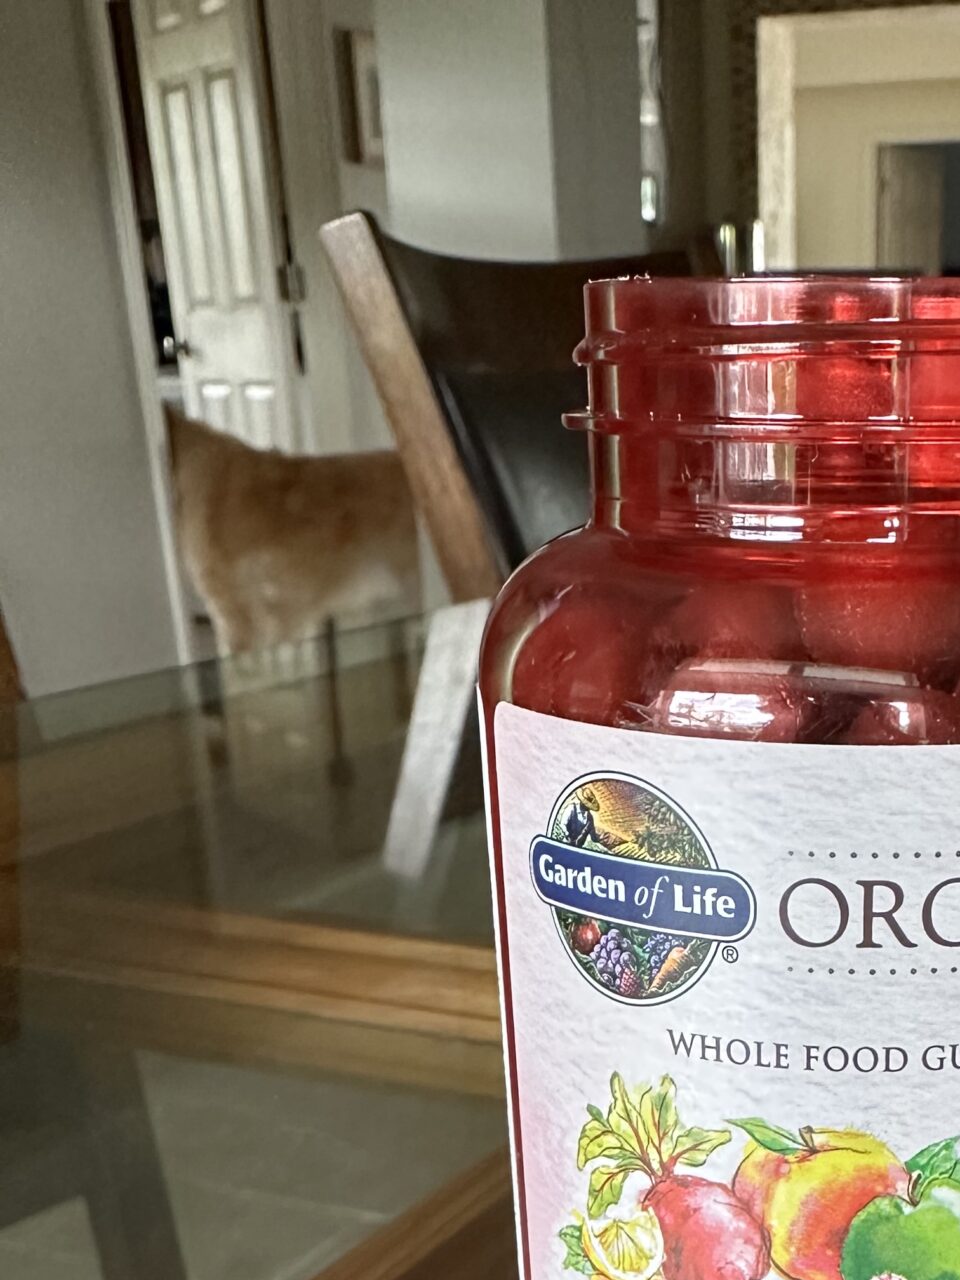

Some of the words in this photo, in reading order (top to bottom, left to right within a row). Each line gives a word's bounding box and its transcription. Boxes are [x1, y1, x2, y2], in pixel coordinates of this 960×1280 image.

[539, 854, 626, 902] Garden
[634, 875, 669, 919] of
[673, 884, 736, 918] Life
[667, 1028, 790, 1070] WHOLE
[803, 1043, 909, 1074] FOOD
